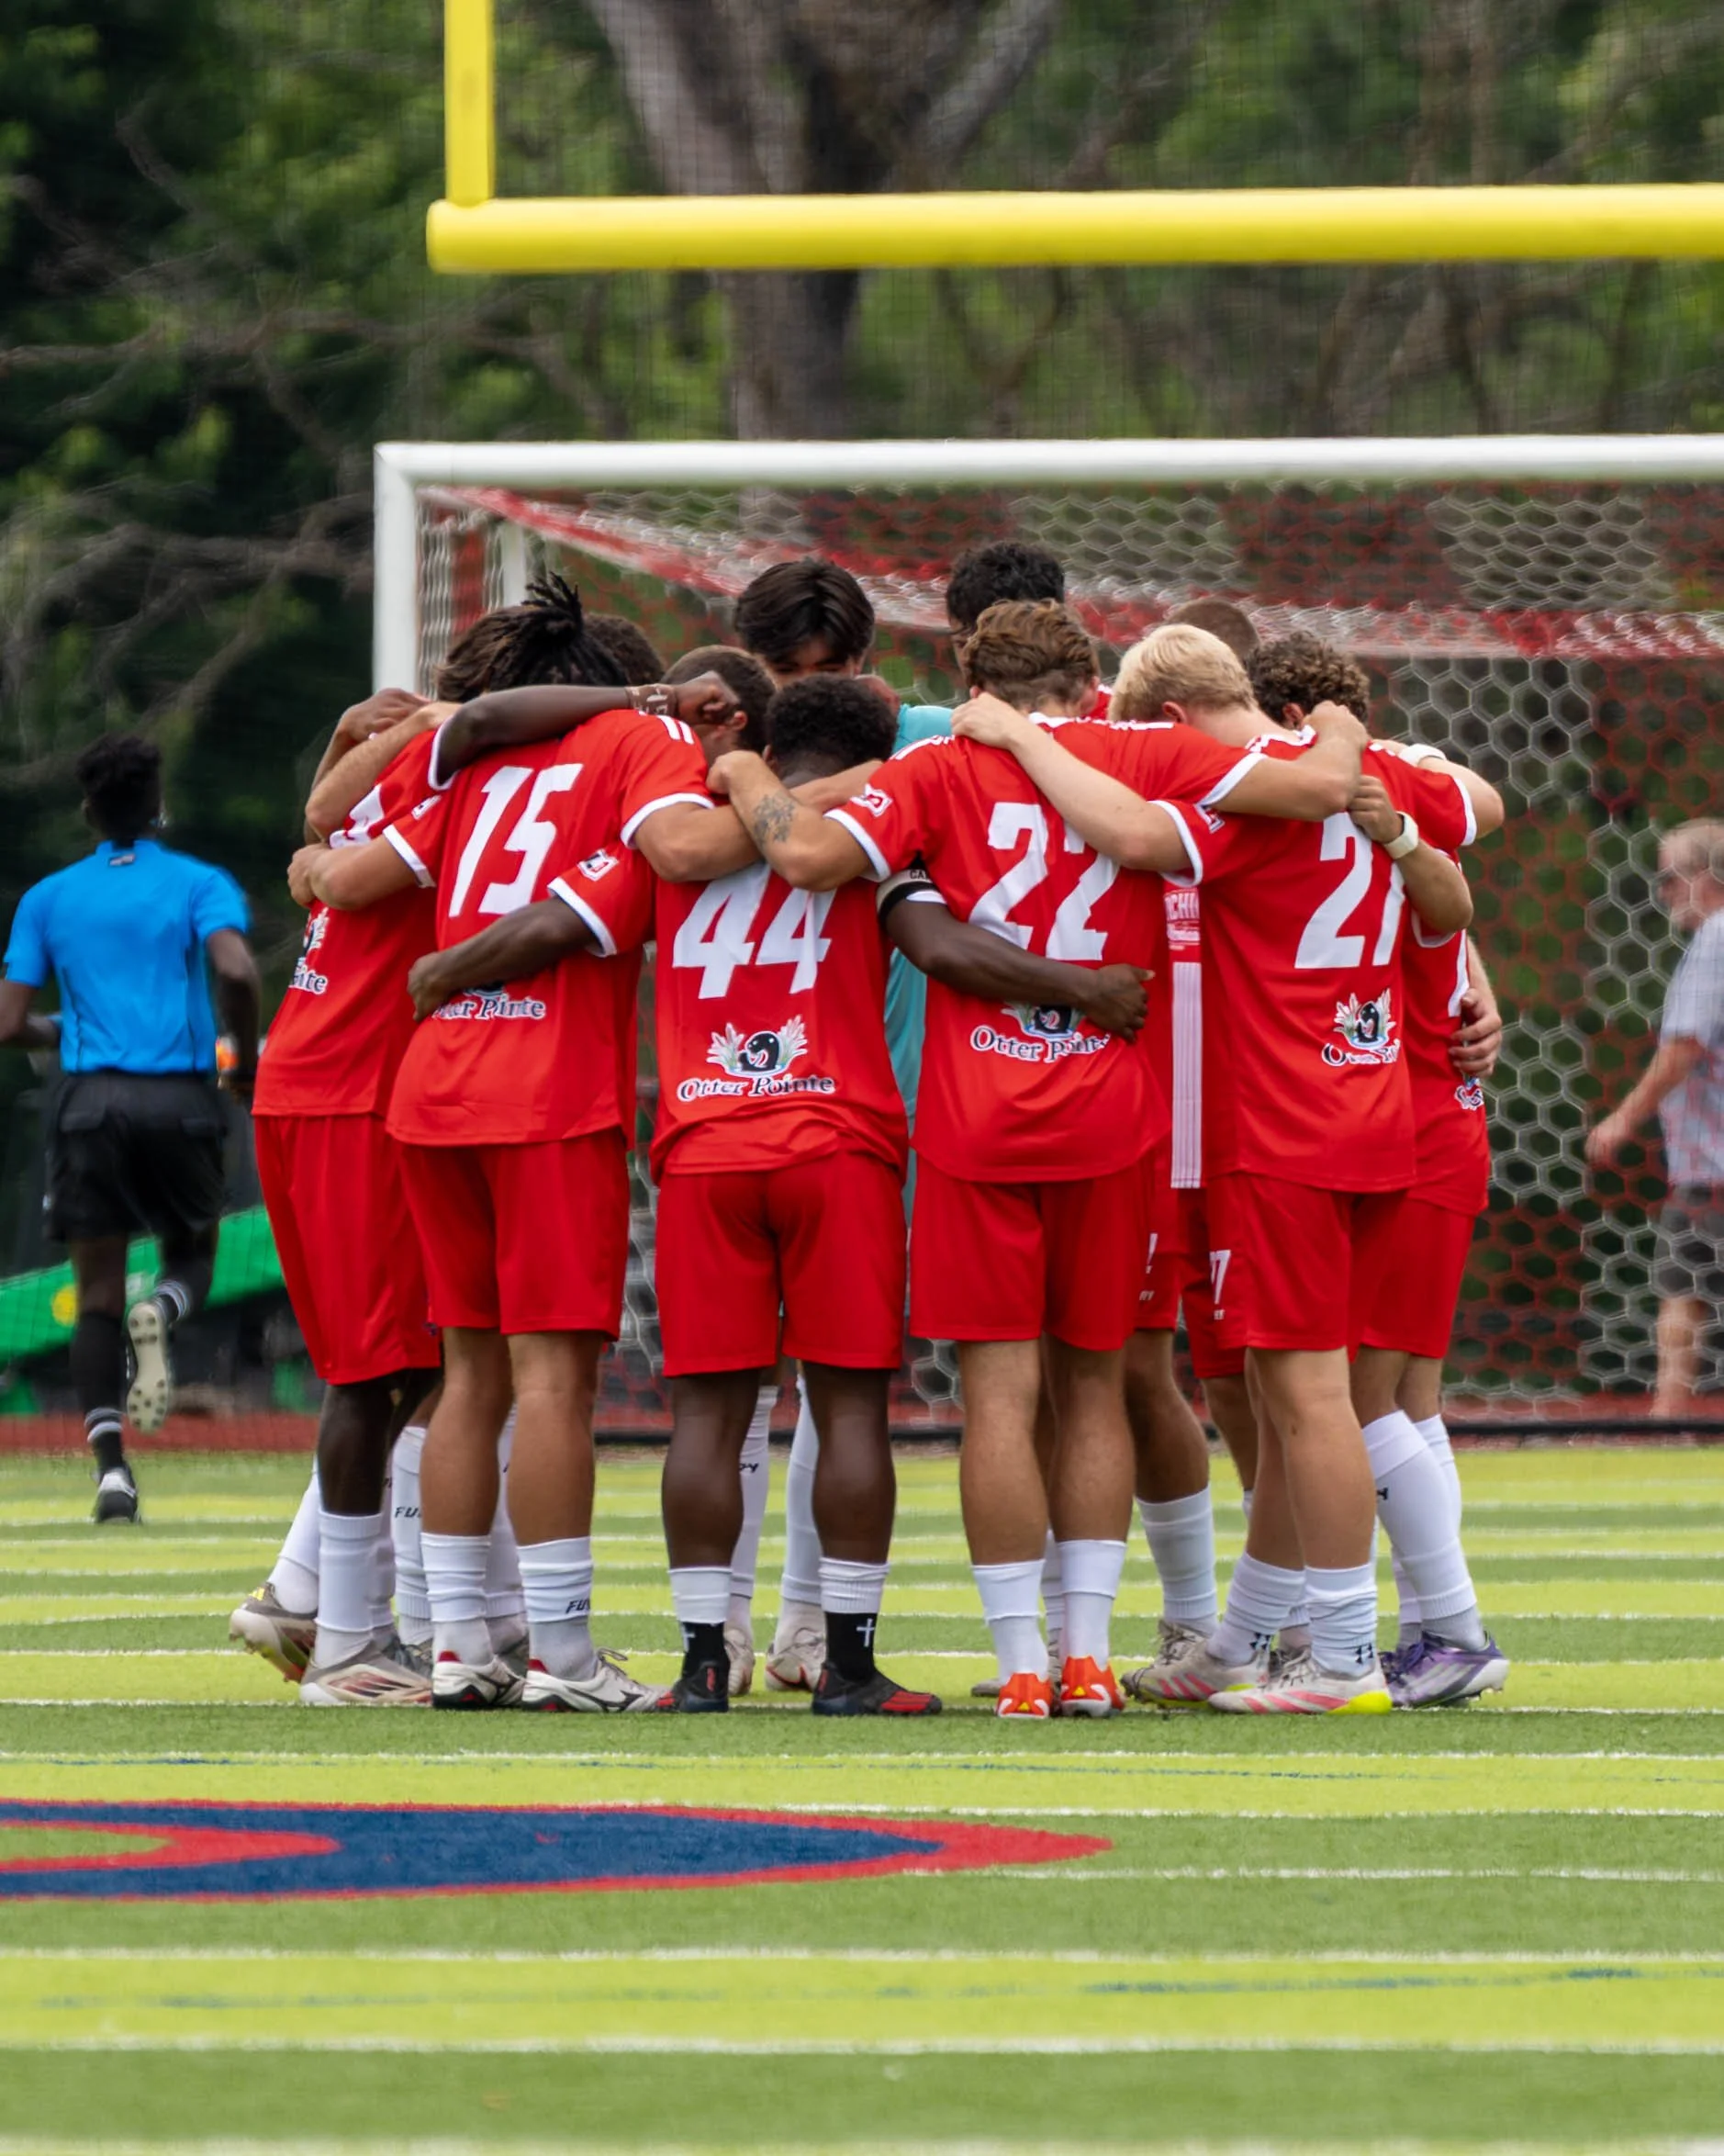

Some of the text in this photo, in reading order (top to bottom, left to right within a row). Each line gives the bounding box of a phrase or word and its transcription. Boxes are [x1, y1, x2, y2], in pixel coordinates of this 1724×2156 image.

[448, 763, 584, 917] 15
[968, 802, 1120, 961] 22
[672, 859, 833, 999] 44
[970, 1026, 1044, 1061] Otter
[677, 1073, 835, 1102] Otter Pointe
[395, 1506, 420, 1519] FU
